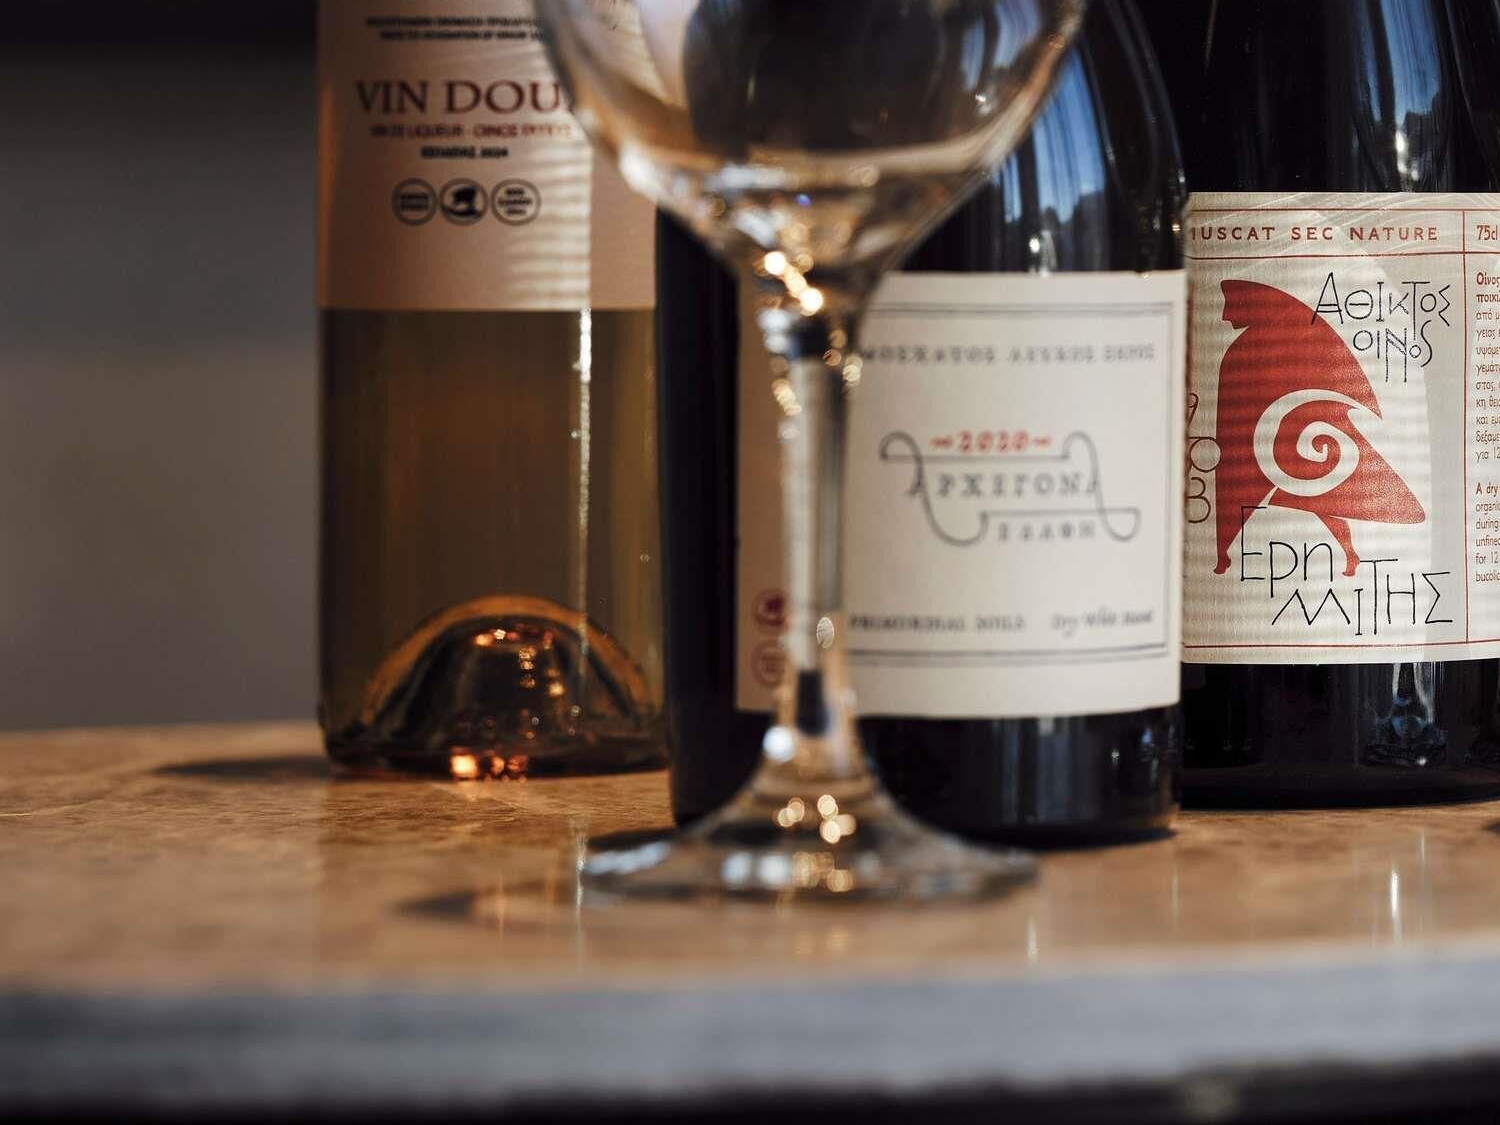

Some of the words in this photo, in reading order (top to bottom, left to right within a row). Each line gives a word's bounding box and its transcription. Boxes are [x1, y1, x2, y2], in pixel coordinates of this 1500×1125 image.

[355, 80, 428, 113] VIN
[443, 80, 575, 114] DOU
[1291, 227, 1333, 241] SEC
[1350, 227, 1438, 241] NATURE
[1476, 224, 1498, 241] 75cl
[1476, 483, 1482, 494] A
[1486, 482, 1498, 497] dry
[1475, 519, 1499, 533] during
[1475, 553, 1486, 565] for
[1491, 551, 1499, 564] 12
